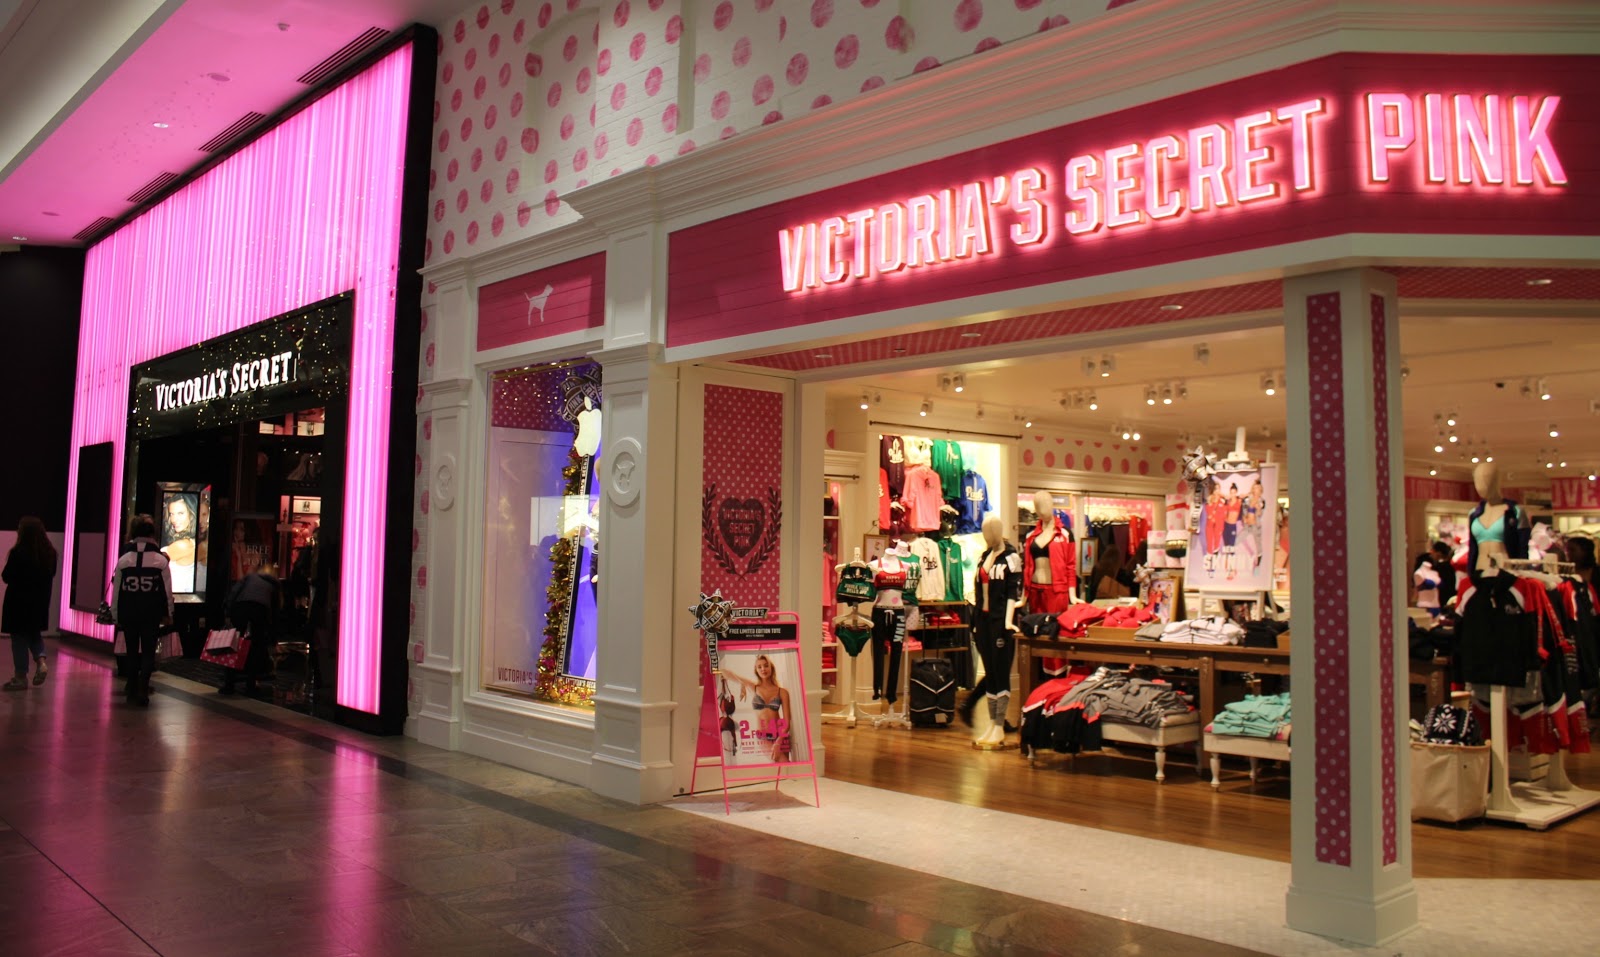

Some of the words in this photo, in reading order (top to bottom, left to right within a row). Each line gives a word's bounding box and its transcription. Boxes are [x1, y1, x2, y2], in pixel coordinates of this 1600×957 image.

[778, 167, 1046, 292] VICTORIA'S
[1063, 97, 1328, 237] SECRET
[1366, 92, 1568, 188] PINK
[155, 368, 227, 412] VICTORIA'S
[231, 351, 293, 394] SECRET
[1551, 479, 1599, 507] OVE
[731, 608, 765, 618] VICTORIA'S
[893, 615, 906, 643] PINK
[498, 667, 533, 686] VICTORIA'S
[739, 720, 751, 739] 2
